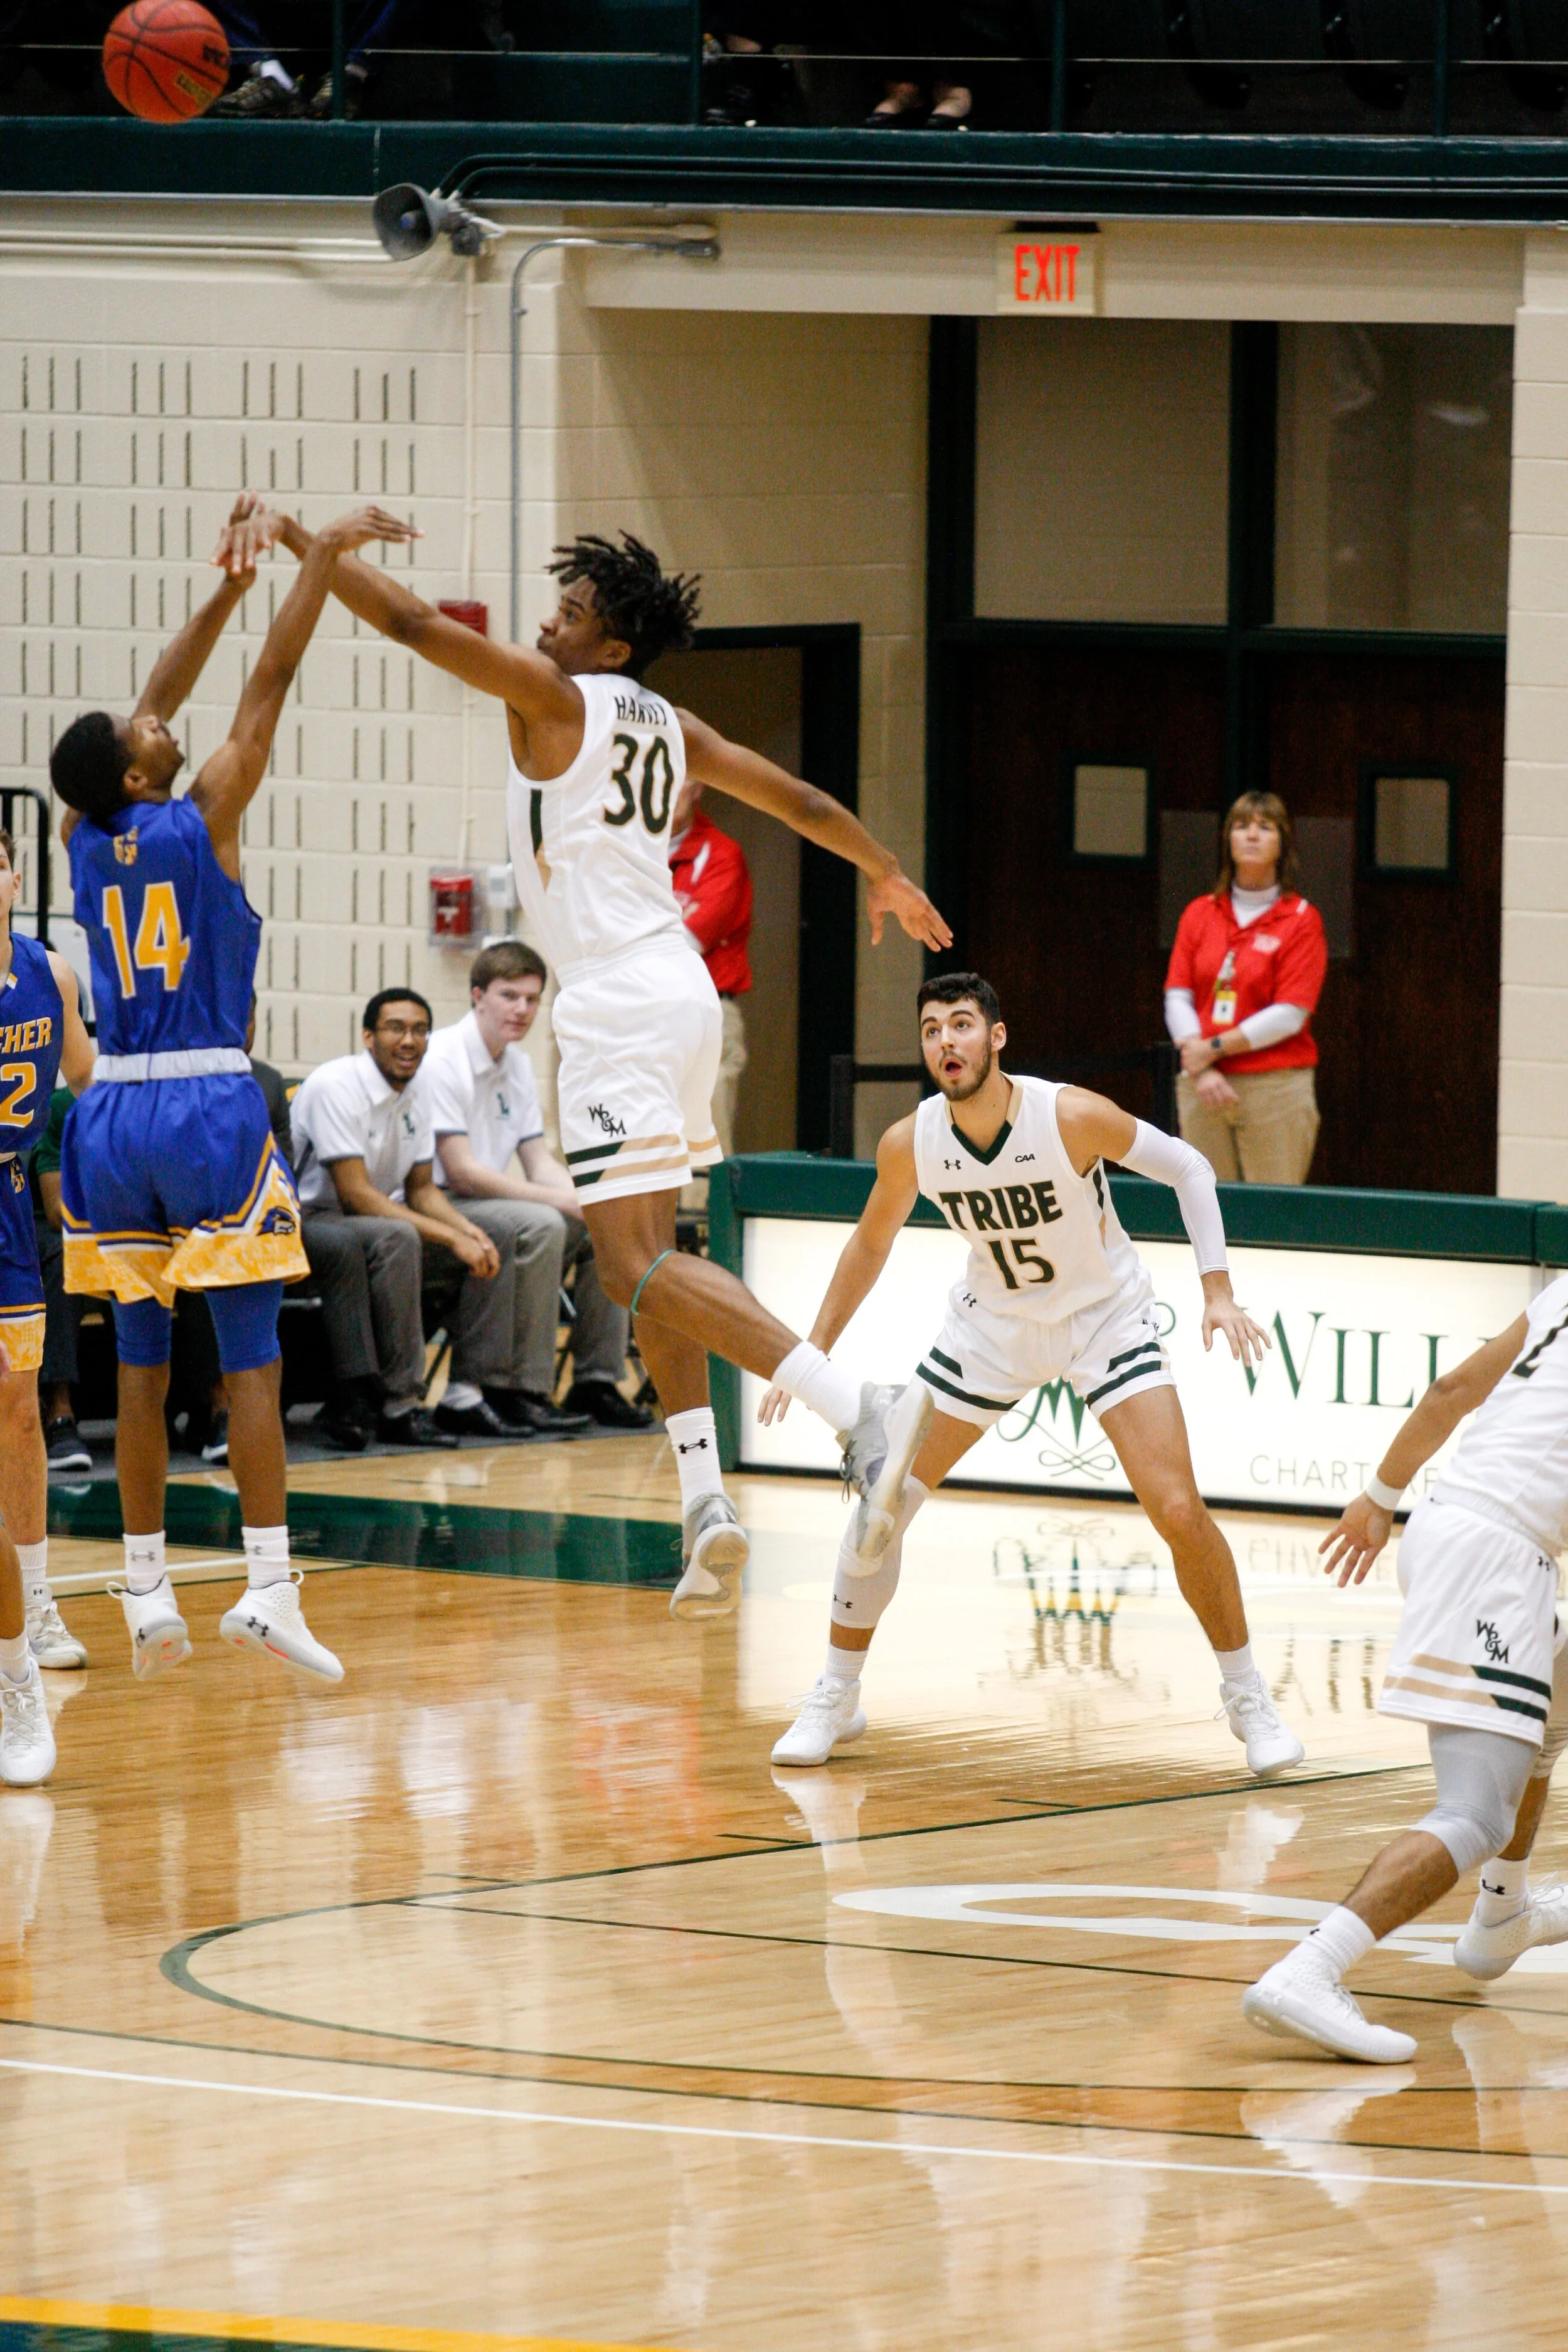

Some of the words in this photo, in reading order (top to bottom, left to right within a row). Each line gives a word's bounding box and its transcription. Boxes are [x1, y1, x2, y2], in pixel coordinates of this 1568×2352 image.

[1015, 244, 1081, 302] EXIT
[603, 733, 675, 835] 30
[102, 881, 191, 999] 14
[1015, 1153, 1036, 1163] CAA
[938, 1180, 1064, 1231] TRIBE
[985, 1237, 1056, 1290] 15
